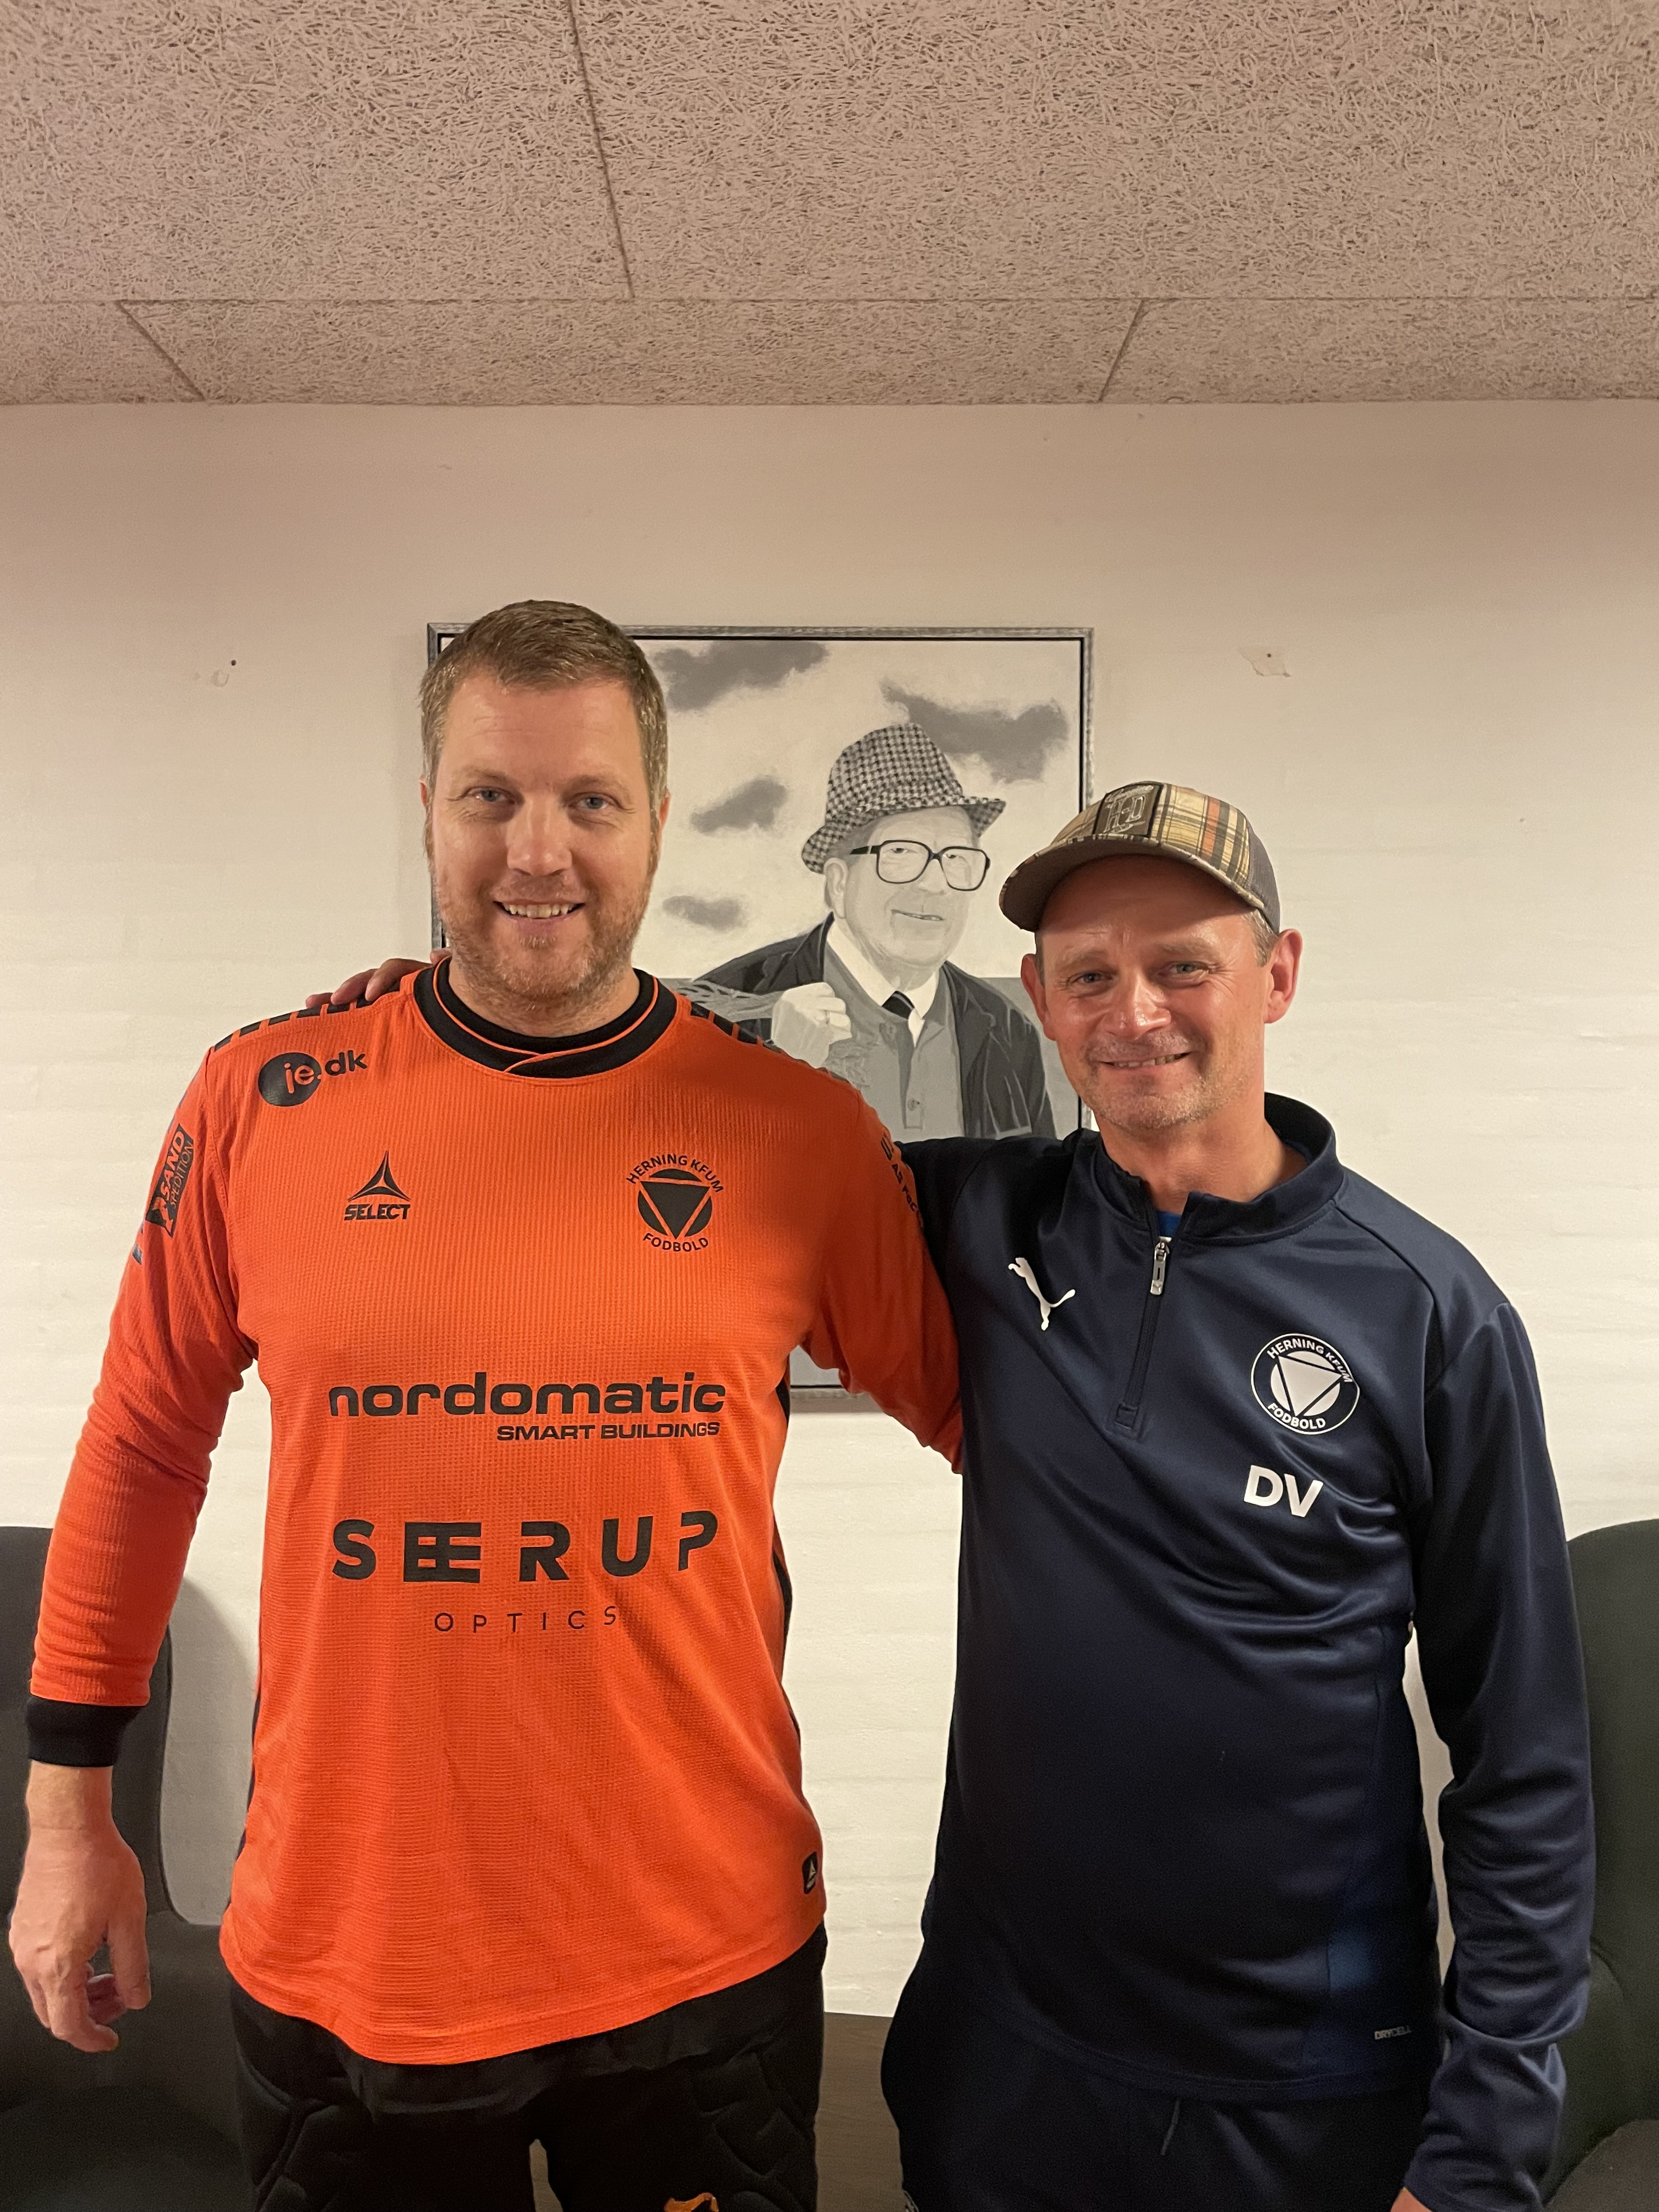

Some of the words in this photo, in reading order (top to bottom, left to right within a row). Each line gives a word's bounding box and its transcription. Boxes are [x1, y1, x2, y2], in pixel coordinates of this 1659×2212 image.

[160, 1131, 184, 1201] SAND
[170, 1141, 194, 1209] SPEDITION
[626, 1154, 687, 1184] HERNING
[690, 1159, 724, 1193] KFUM
[344, 1204, 411, 1221] SELECT
[643, 1233, 709, 1252] FODBOLD
[1267, 1339, 1324, 1359] HERNING
[1325, 1352, 1353, 1383] KFUM
[329, 1372, 726, 1417] nordomatic
[496, 1424, 595, 1441] SMART
[601, 1421, 720, 1440] BUILDINGS
[1267, 1402, 1326, 1430] FODBOLD
[1243, 1465, 1324, 1517] DV
[434, 1605, 617, 1633] OPTICS
[1374, 2025, 1412, 2040] DRYCELL
